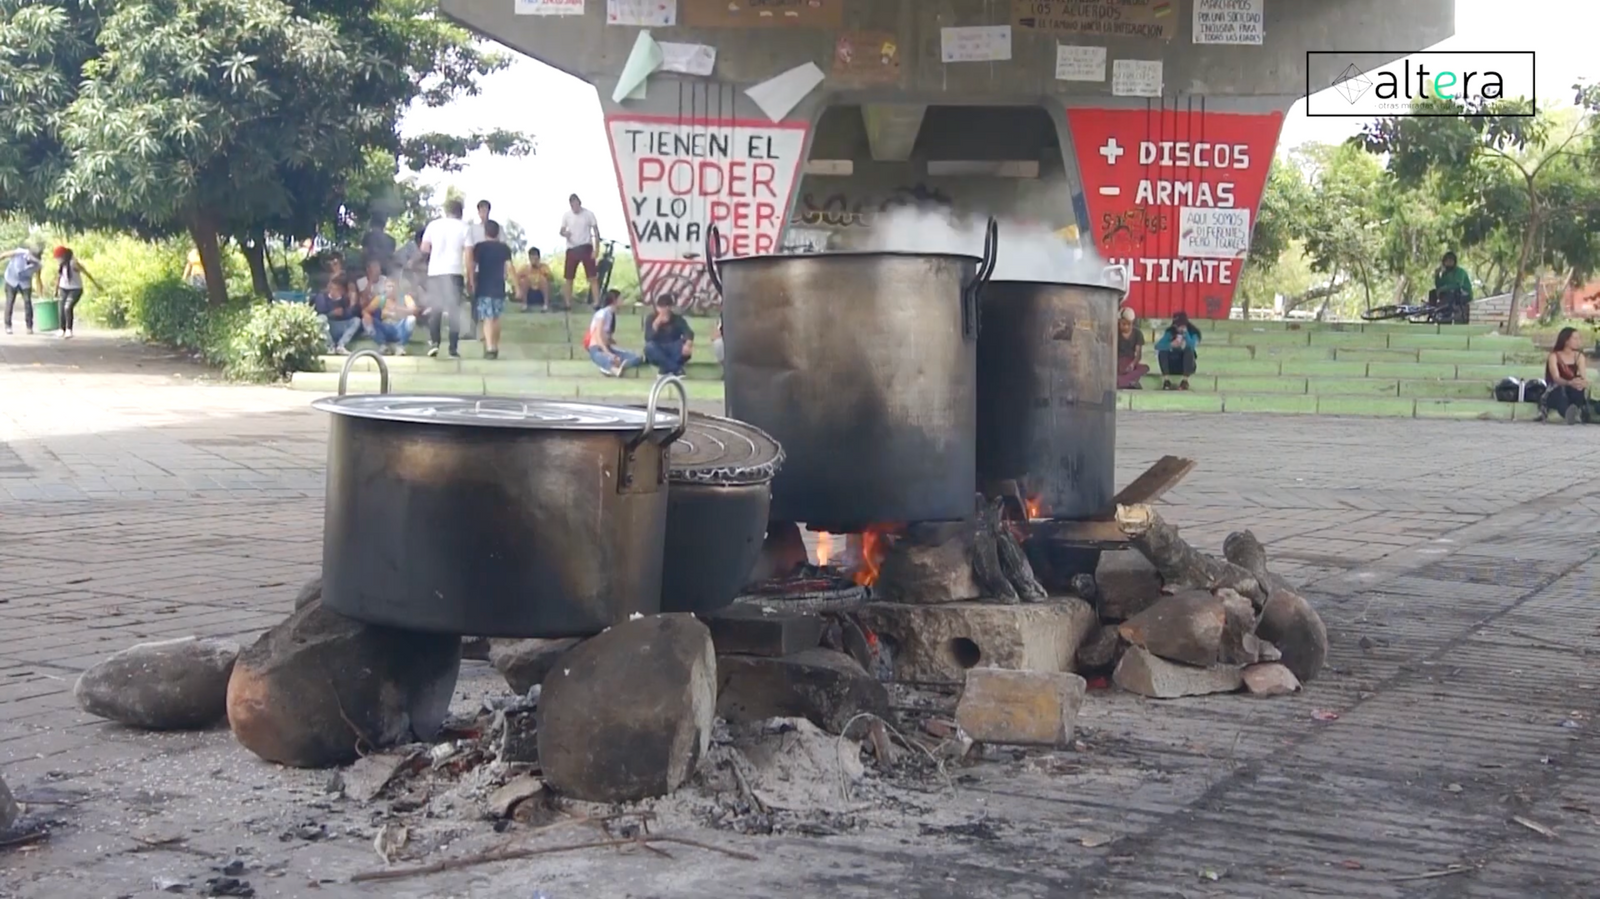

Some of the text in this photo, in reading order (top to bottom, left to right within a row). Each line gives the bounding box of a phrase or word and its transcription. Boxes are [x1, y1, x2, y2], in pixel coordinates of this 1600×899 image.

[1062, 4, 1121, 20] ACUERDOS
[625, 129, 780, 159] TIENEN EL
[1139, 141, 1250, 169] DISCOS
[638, 157, 778, 198] PODER
[1135, 180, 1235, 208] ARMAS
[632, 196, 687, 218] Y LO
[1212, 213, 1243, 226] SOMOS
[632, 220, 700, 243] VAN A
[1197, 226, 1246, 240] DIFERENTES
[1108, 257, 1232, 284] ULTIMATE
